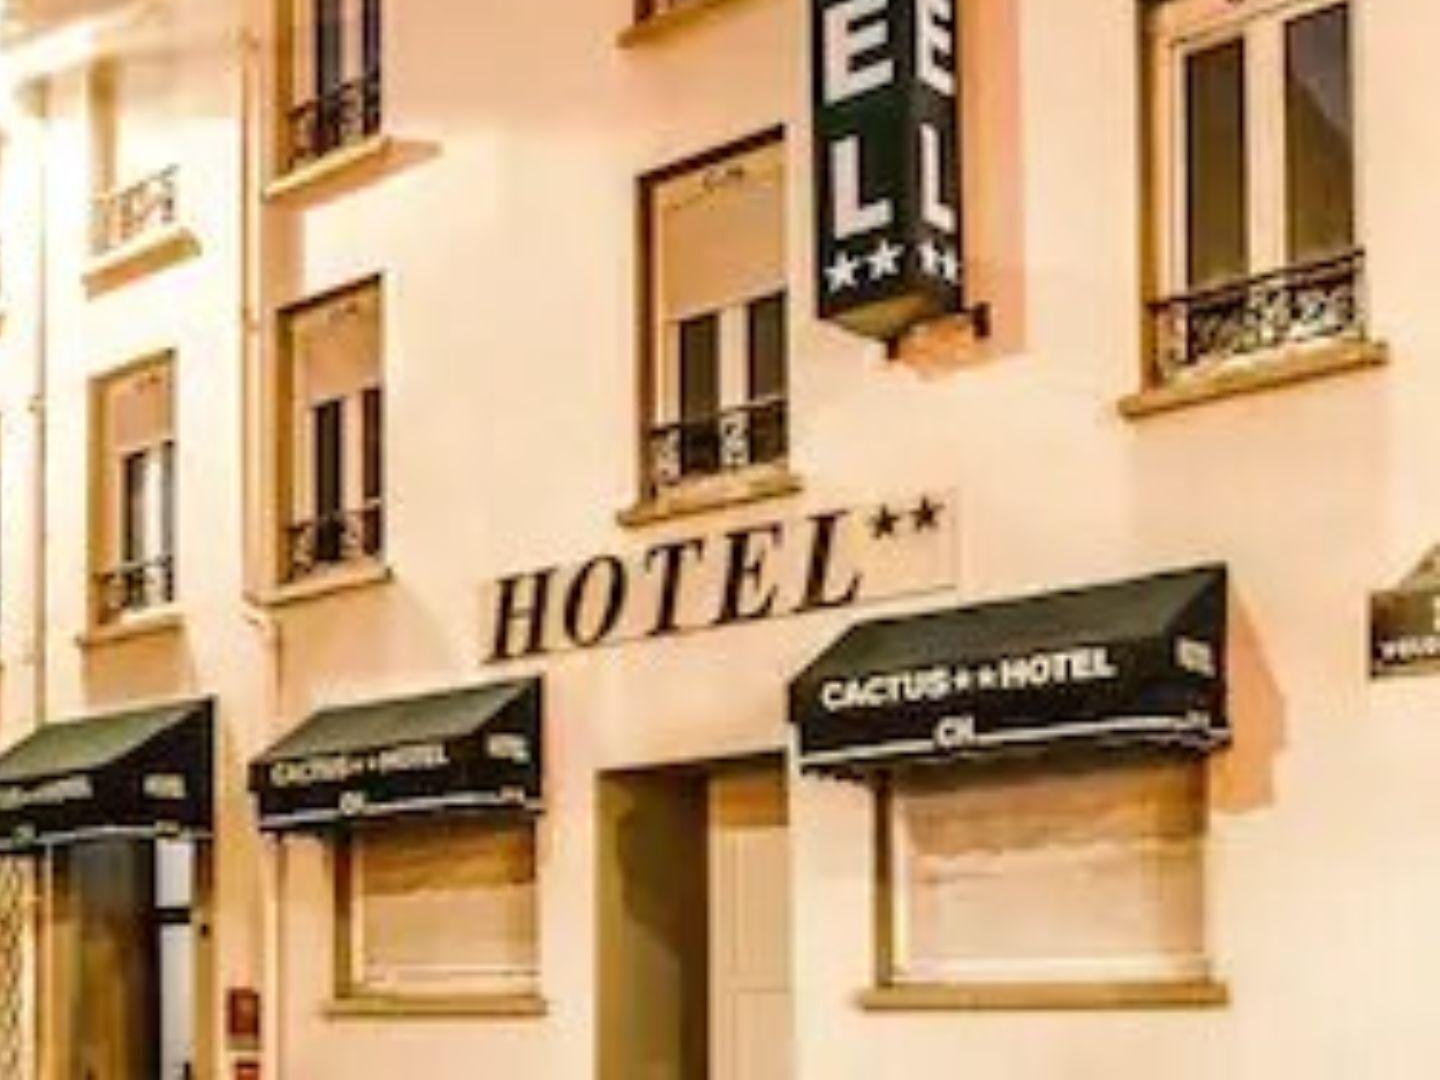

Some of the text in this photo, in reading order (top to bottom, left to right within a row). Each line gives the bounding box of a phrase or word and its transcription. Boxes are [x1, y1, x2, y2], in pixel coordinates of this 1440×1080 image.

[482, 508, 862, 665] HOTEL
[821, 664, 951, 712] CACTUS
[1000, 646, 1118, 690] HOTEL
